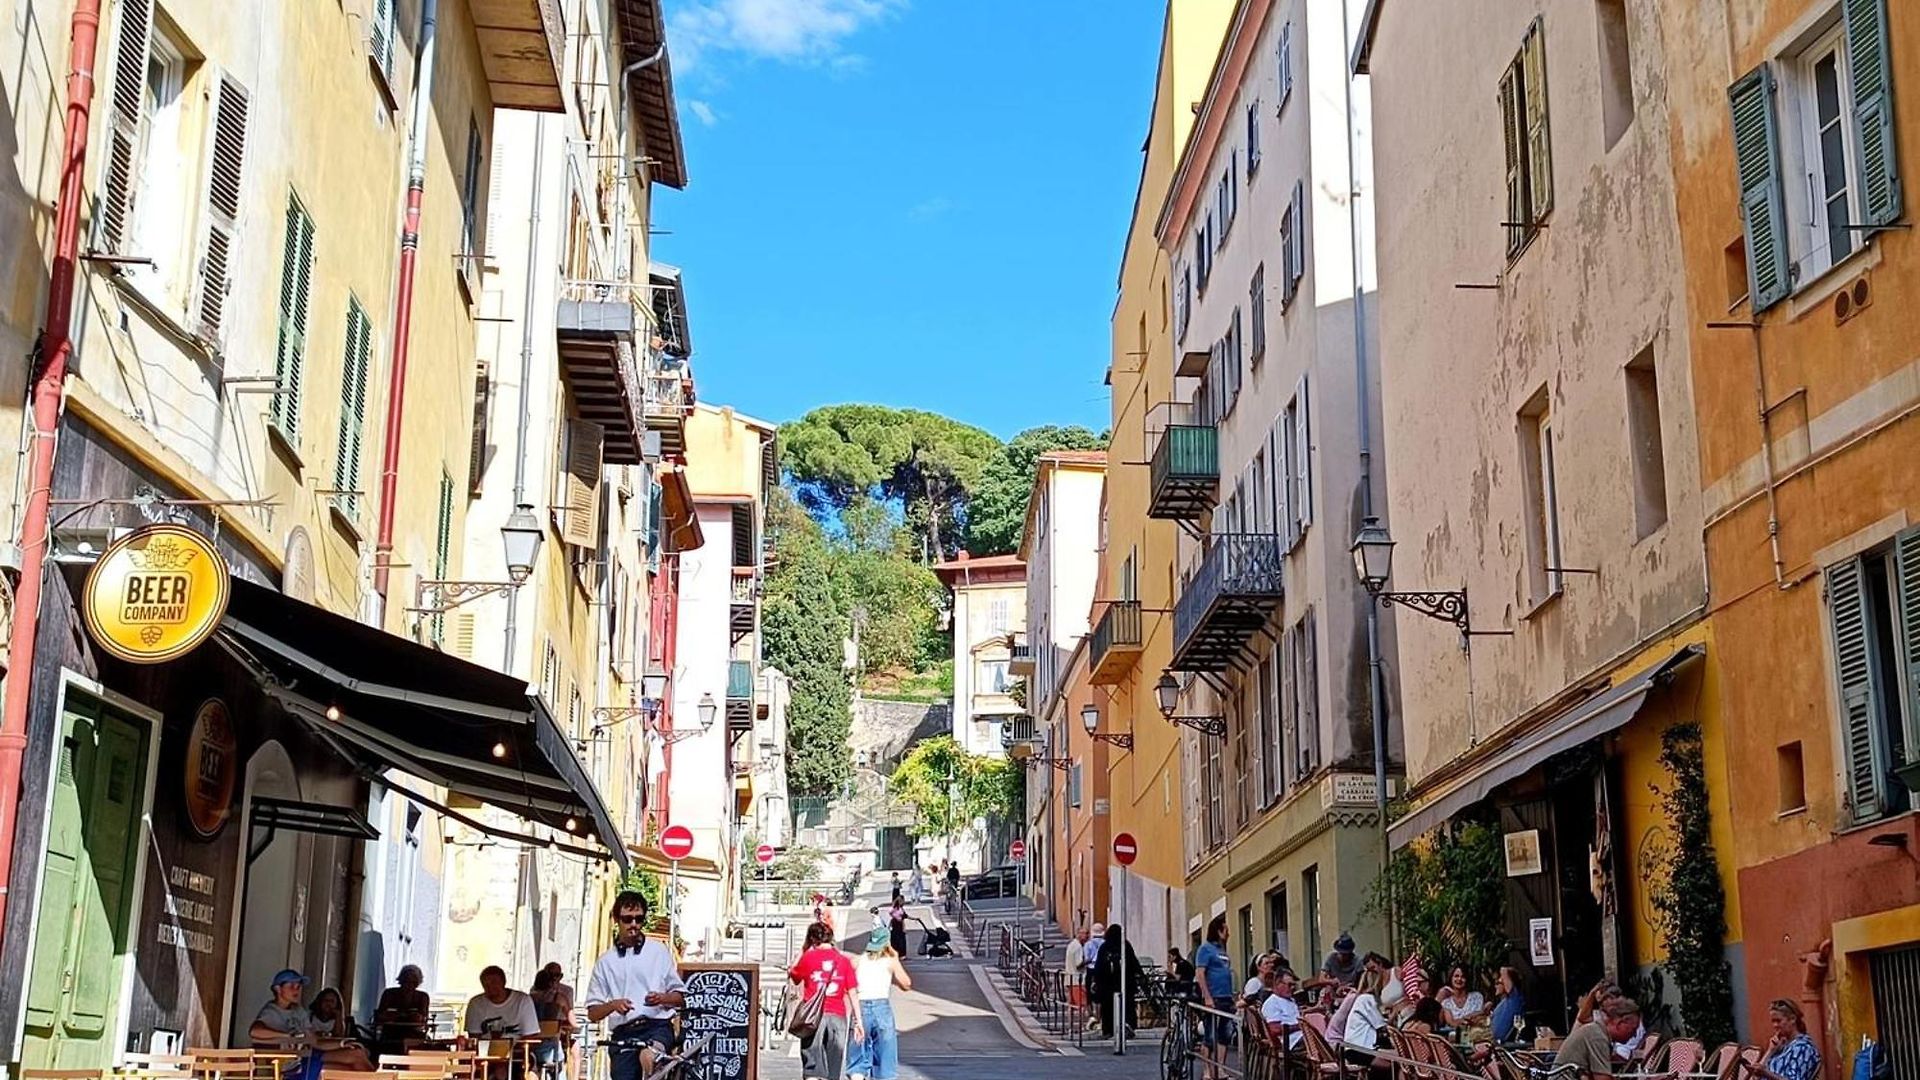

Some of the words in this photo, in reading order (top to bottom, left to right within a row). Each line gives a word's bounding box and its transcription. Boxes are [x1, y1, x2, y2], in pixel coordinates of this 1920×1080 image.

[126, 576, 187, 604] BEER
[124, 606, 184, 621] COMPANY
[170, 865, 189, 889] CRAFT
